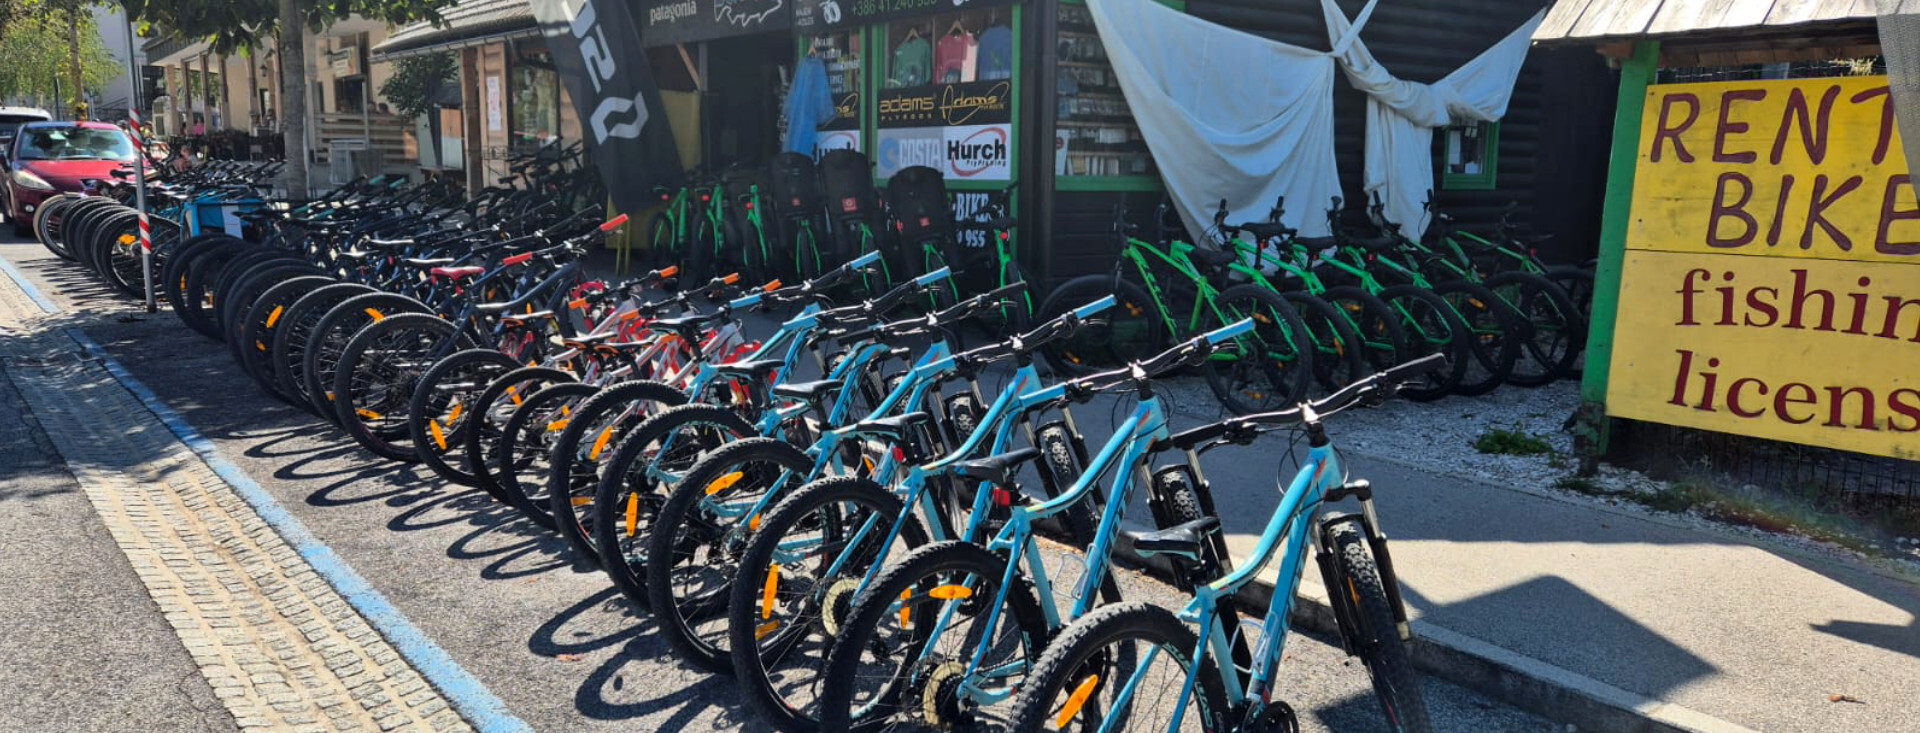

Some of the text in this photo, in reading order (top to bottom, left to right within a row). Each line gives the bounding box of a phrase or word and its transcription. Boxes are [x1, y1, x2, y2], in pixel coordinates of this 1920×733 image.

[650, 0, 697, 26] patagonia
[852, 0, 876, 16] +386
[878, 0, 890, 12] 41
[880, 94, 934, 113] adams
[1651, 85, 1895, 165] RENT
[899, 138, 941, 167] COSTA
[948, 139, 1007, 162] Hurch
[955, 192, 989, 222] BIKE
[1706, 171, 1920, 254] BIKE
[965, 229, 986, 248] 955
[1675, 268, 1920, 343] fishin
[1667, 350, 1920, 431] licens
